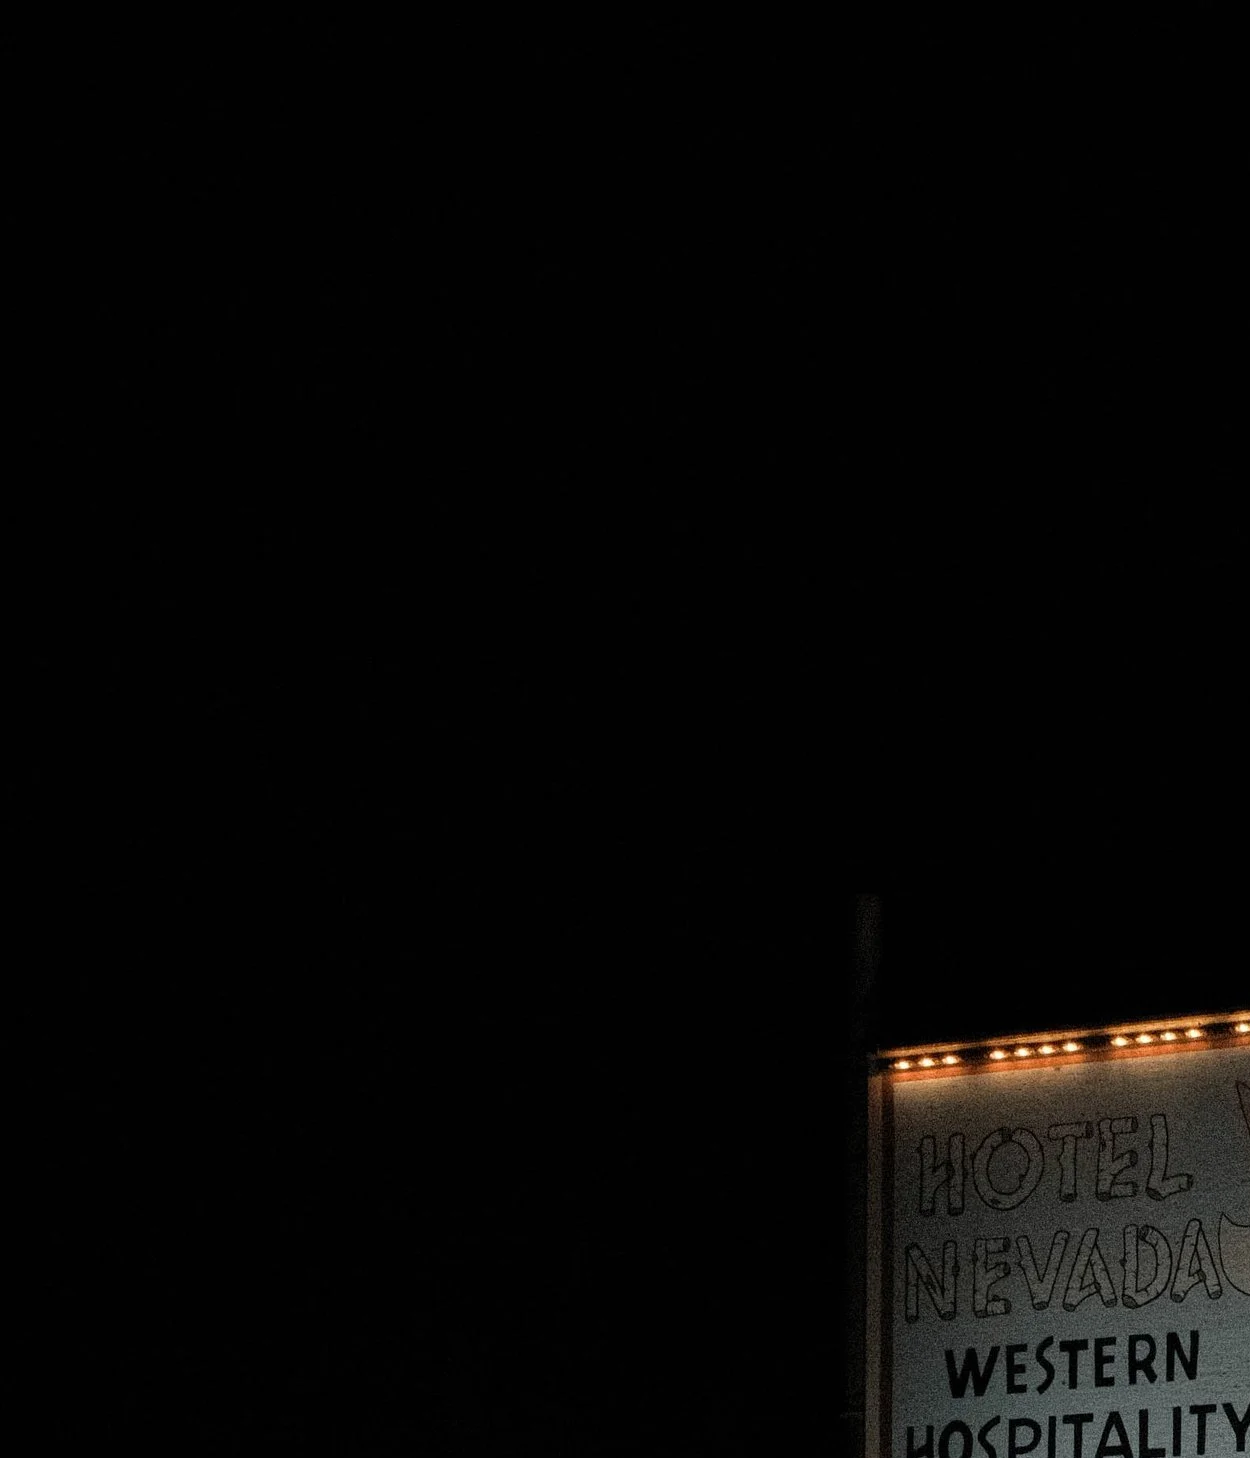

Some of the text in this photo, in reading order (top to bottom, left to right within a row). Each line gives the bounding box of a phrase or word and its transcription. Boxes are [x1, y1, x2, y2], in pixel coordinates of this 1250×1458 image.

[917, 1114, 1193, 1217] HOTEL
[904, 1218, 1223, 1323] NEVADA
[944, 1329, 1200, 1399] WESTERN
